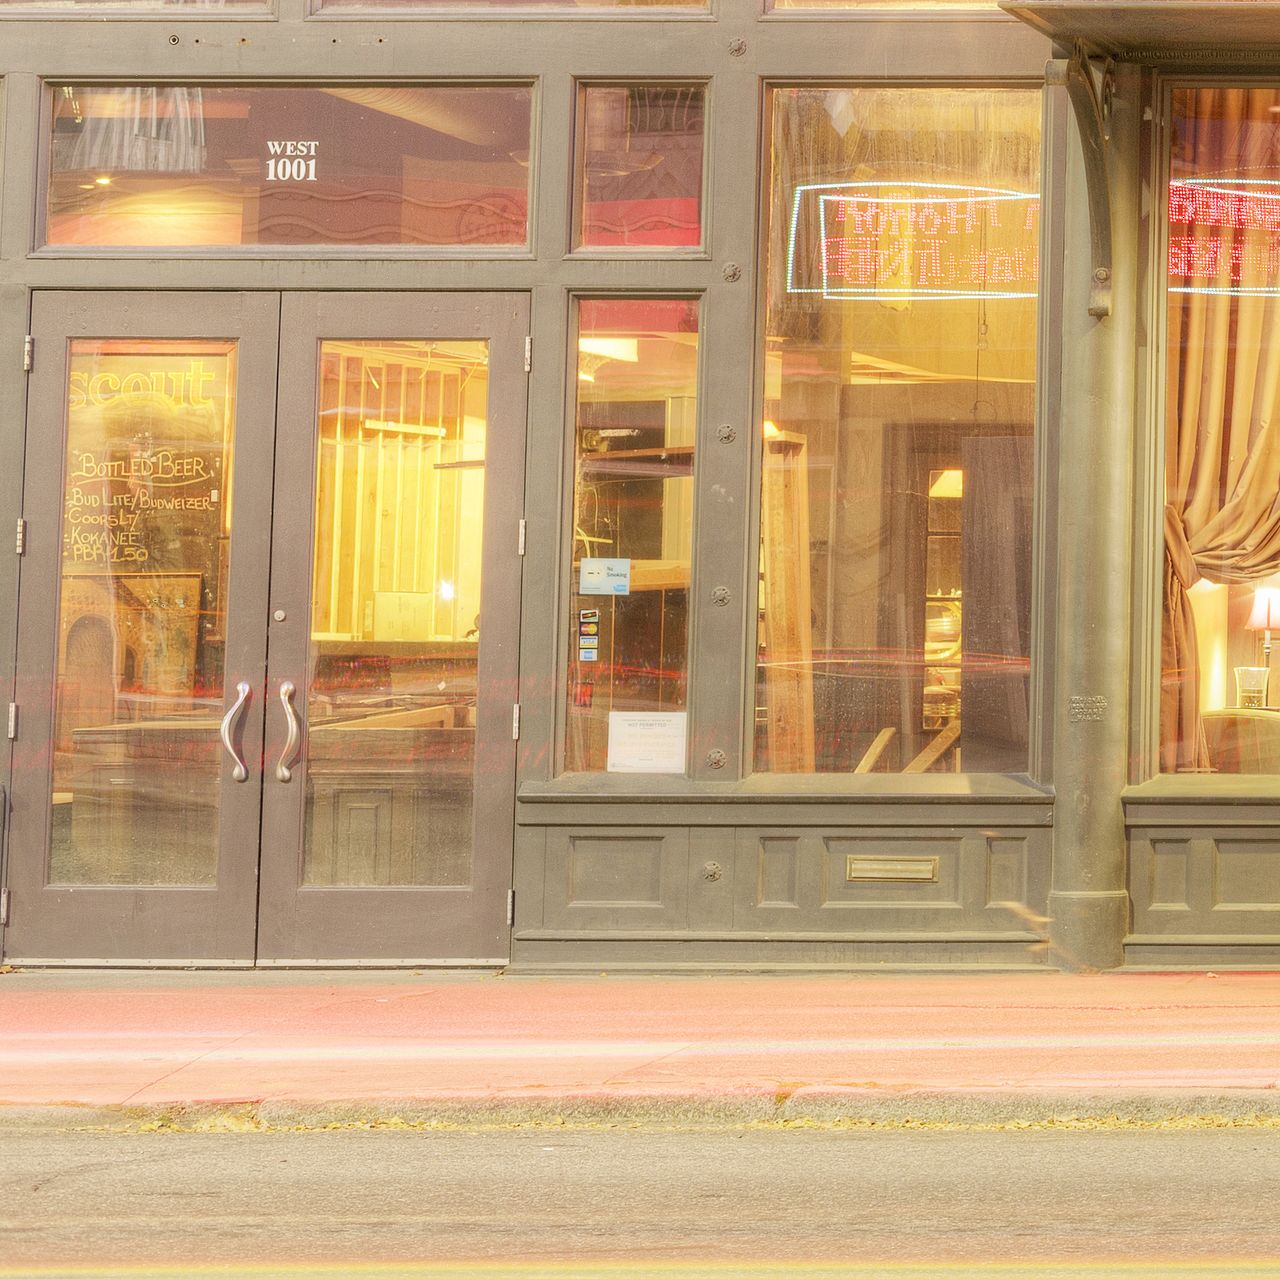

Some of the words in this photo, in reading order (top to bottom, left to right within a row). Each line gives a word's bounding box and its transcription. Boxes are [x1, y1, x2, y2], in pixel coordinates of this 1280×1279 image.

[267, 141, 319, 156] WEST
[266, 158, 318, 181] 1001
[69, 359, 215, 409] scout
